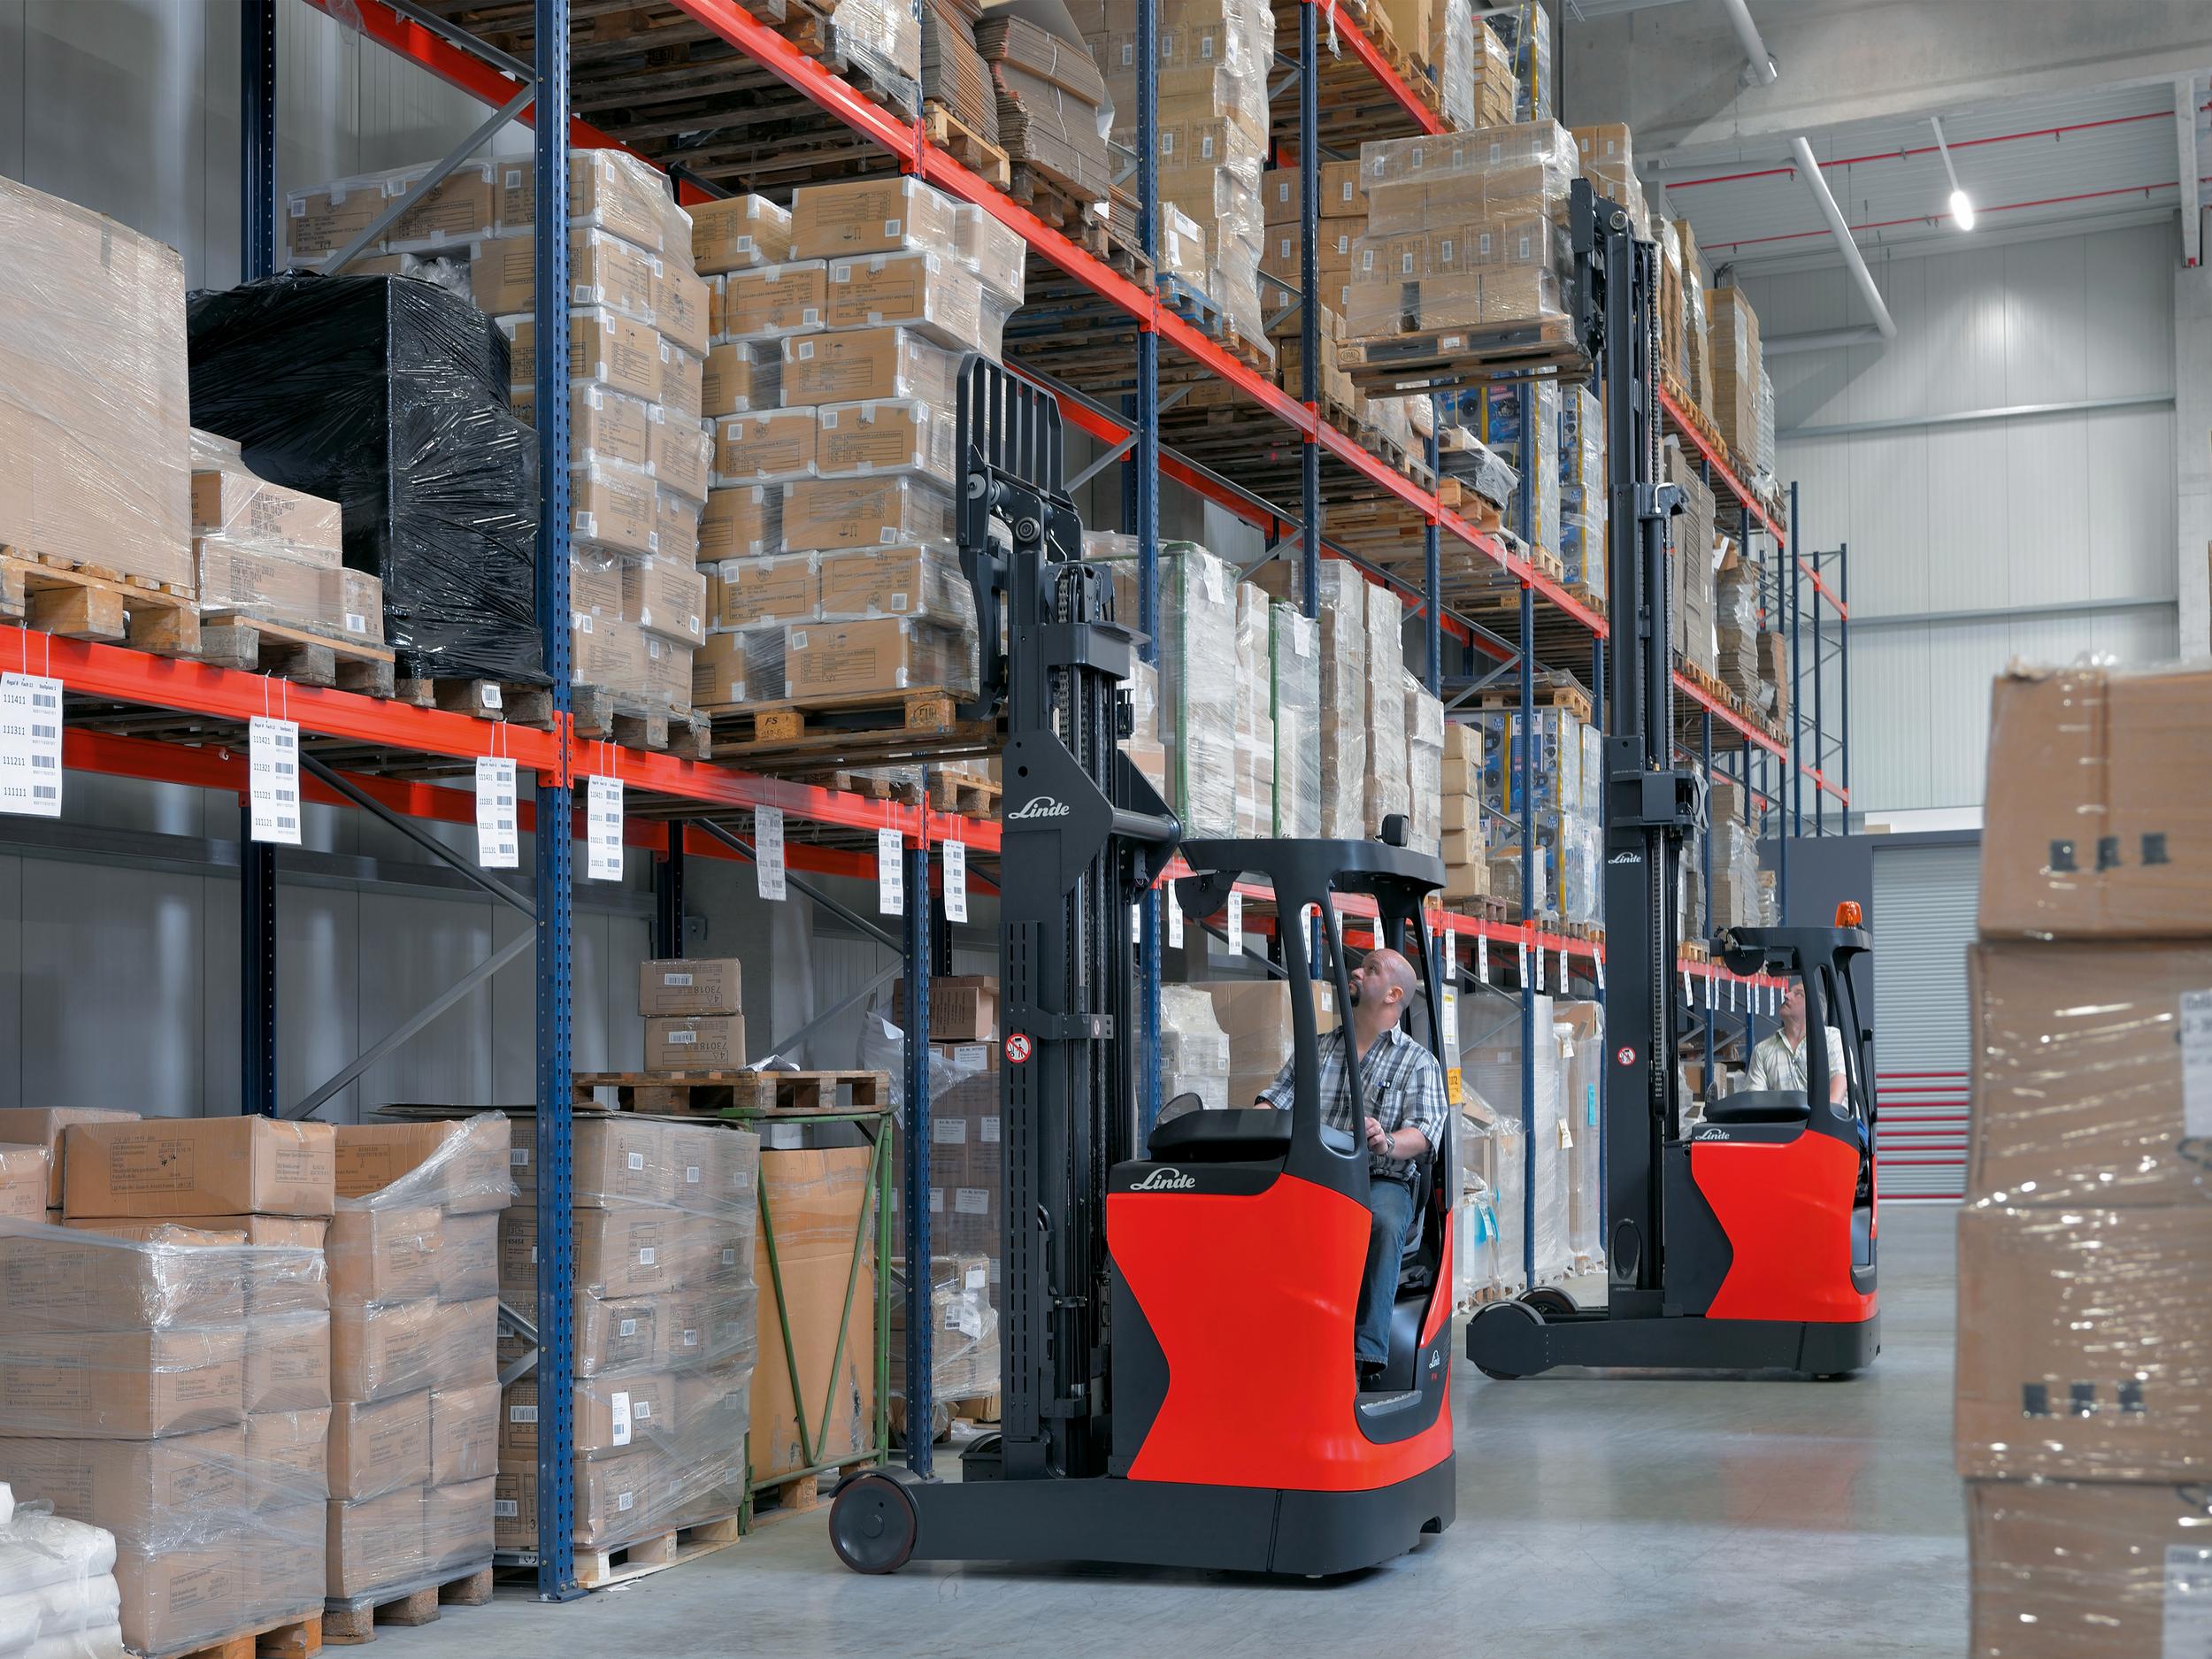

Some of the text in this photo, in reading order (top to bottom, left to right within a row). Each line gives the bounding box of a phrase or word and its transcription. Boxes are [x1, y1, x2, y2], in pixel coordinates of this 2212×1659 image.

[4, 694, 26, 705] 111411
[3, 725, 25, 735] 111311
[253, 735, 271, 745] 111421
[3, 756, 25, 766] 111211
[253, 763, 271, 772] 111321
[4, 787, 27, 797] 111111
[253, 790, 271, 800] 111221
[1008, 796, 1070, 819] Linde
[255, 818, 273, 827] 111121
[1608, 851, 1642, 864] Linde
[1694, 1128, 1731, 1141] Linde
[1129, 1167, 1196, 1191] Linde
